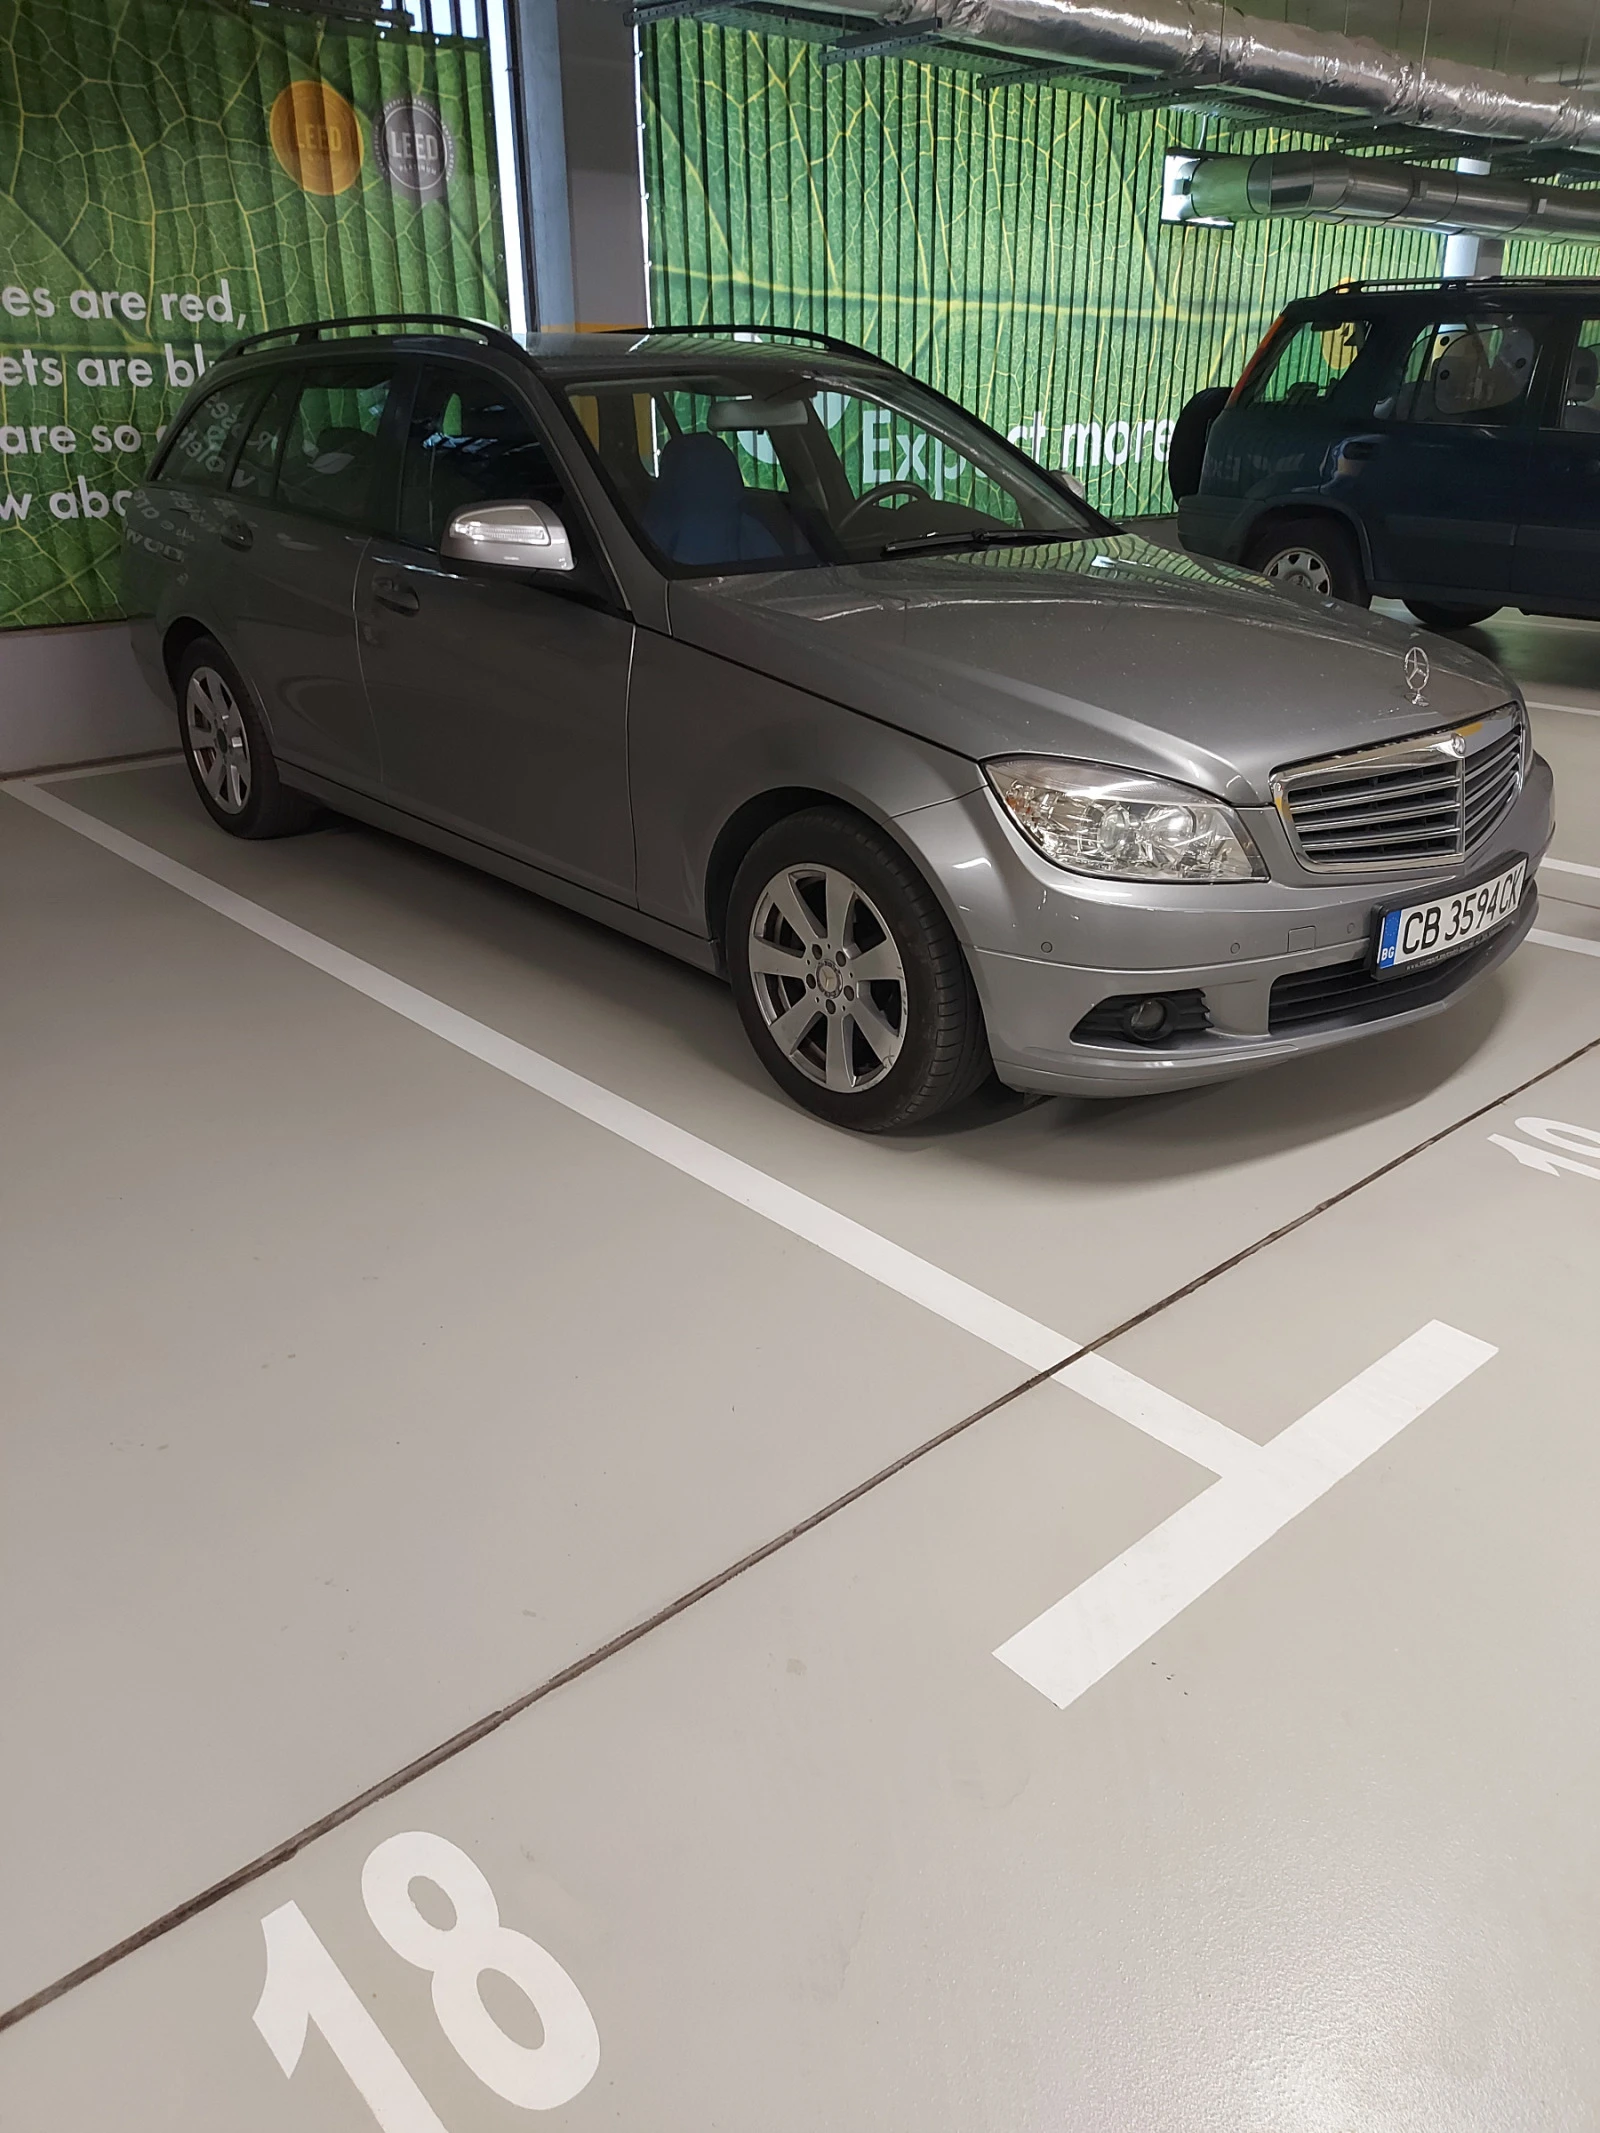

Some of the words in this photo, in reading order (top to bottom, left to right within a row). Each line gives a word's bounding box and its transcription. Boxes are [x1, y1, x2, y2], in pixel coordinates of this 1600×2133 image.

[390, 131, 439, 161] LEED
[70, 288, 147, 320] are
[161, 278, 247, 330] red,
[77, 357, 153, 388] are
[164, 343, 215, 388] bl
[0, 425, 77, 455] are
[91, 425, 142, 453] so
[1062, 418, 1177, 469] more
[1402, 906, 1441, 955] CB
[1444, 883, 1498, 942] 3594
[1380, 947, 1395, 961] BG
[252, 1831, 601, 2133] 18
